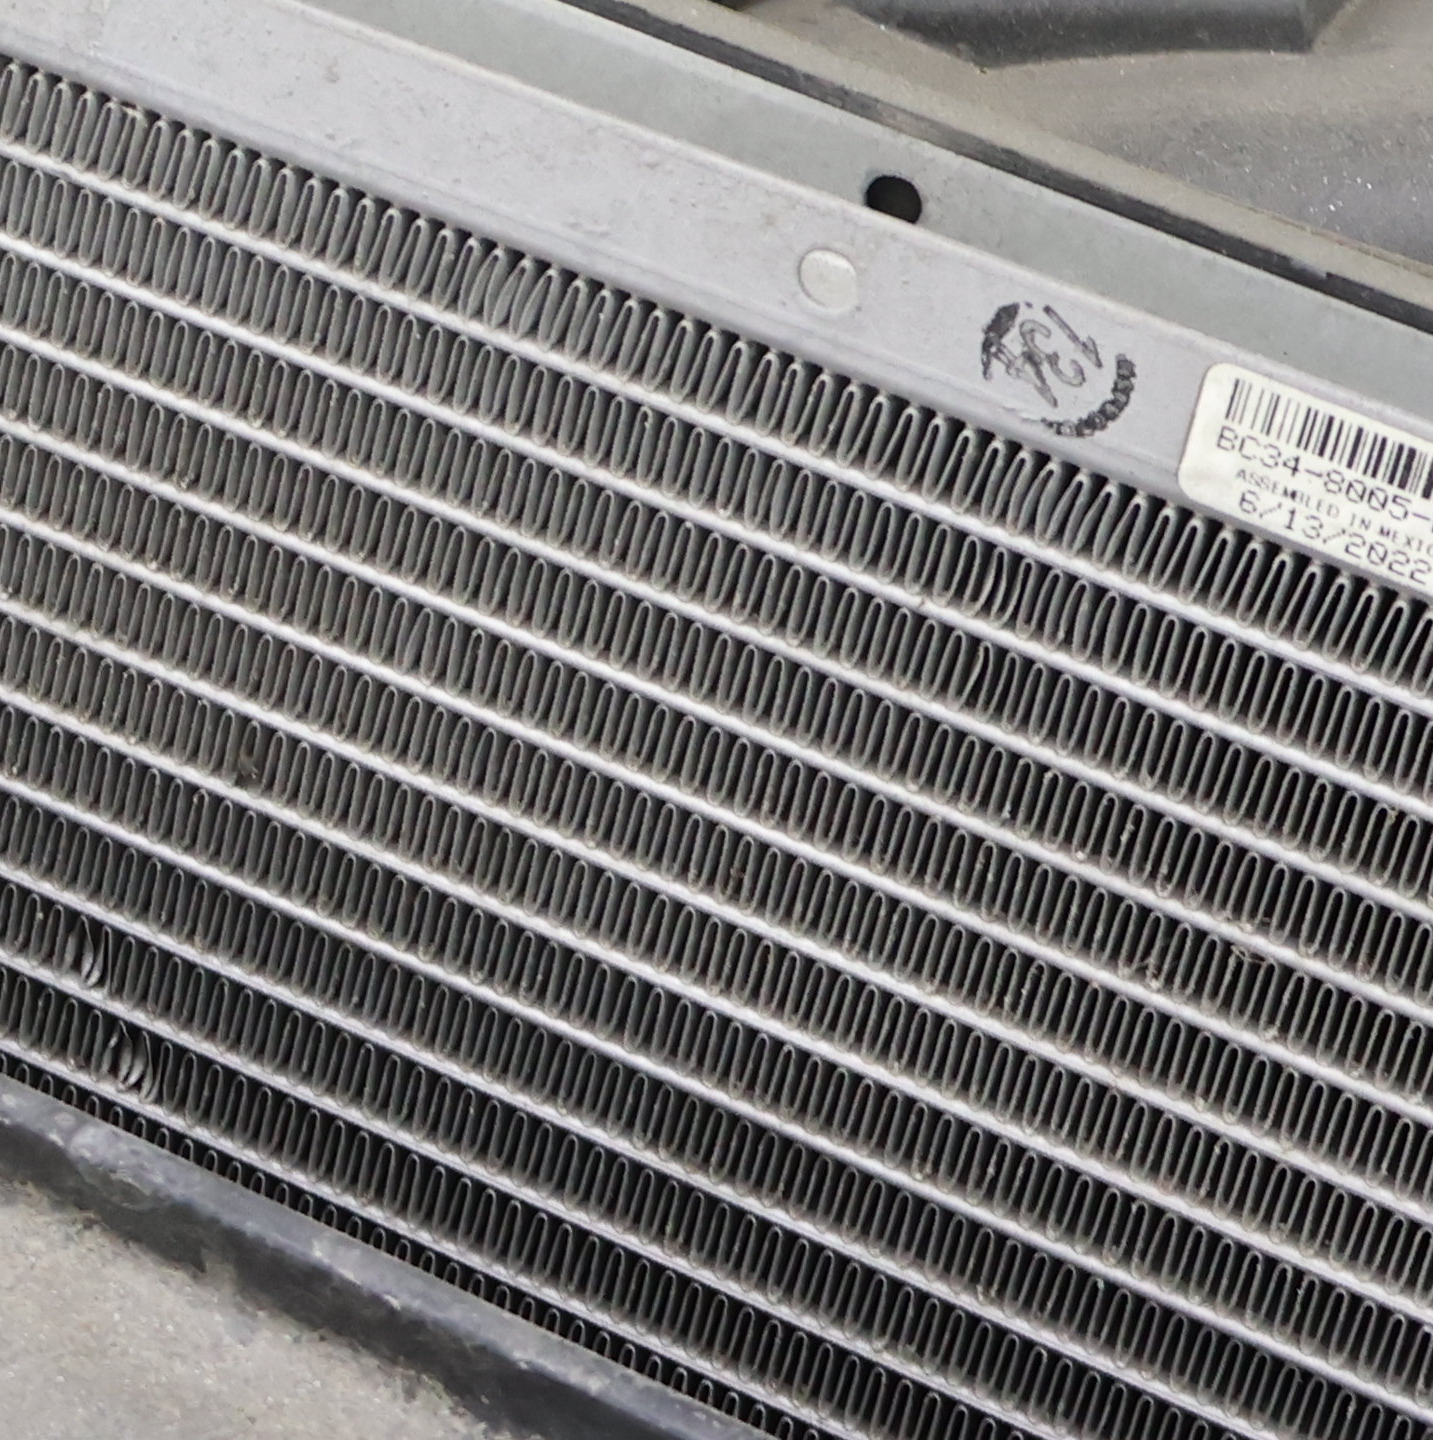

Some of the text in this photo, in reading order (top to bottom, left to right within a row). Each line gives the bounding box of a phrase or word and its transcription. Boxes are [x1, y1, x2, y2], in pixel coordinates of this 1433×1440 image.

[1236, 469, 1340, 519] ASSEMBLED
[1350, 513, 1372, 531] IN
[1239, 490, 1432, 586] 6/13/2022
